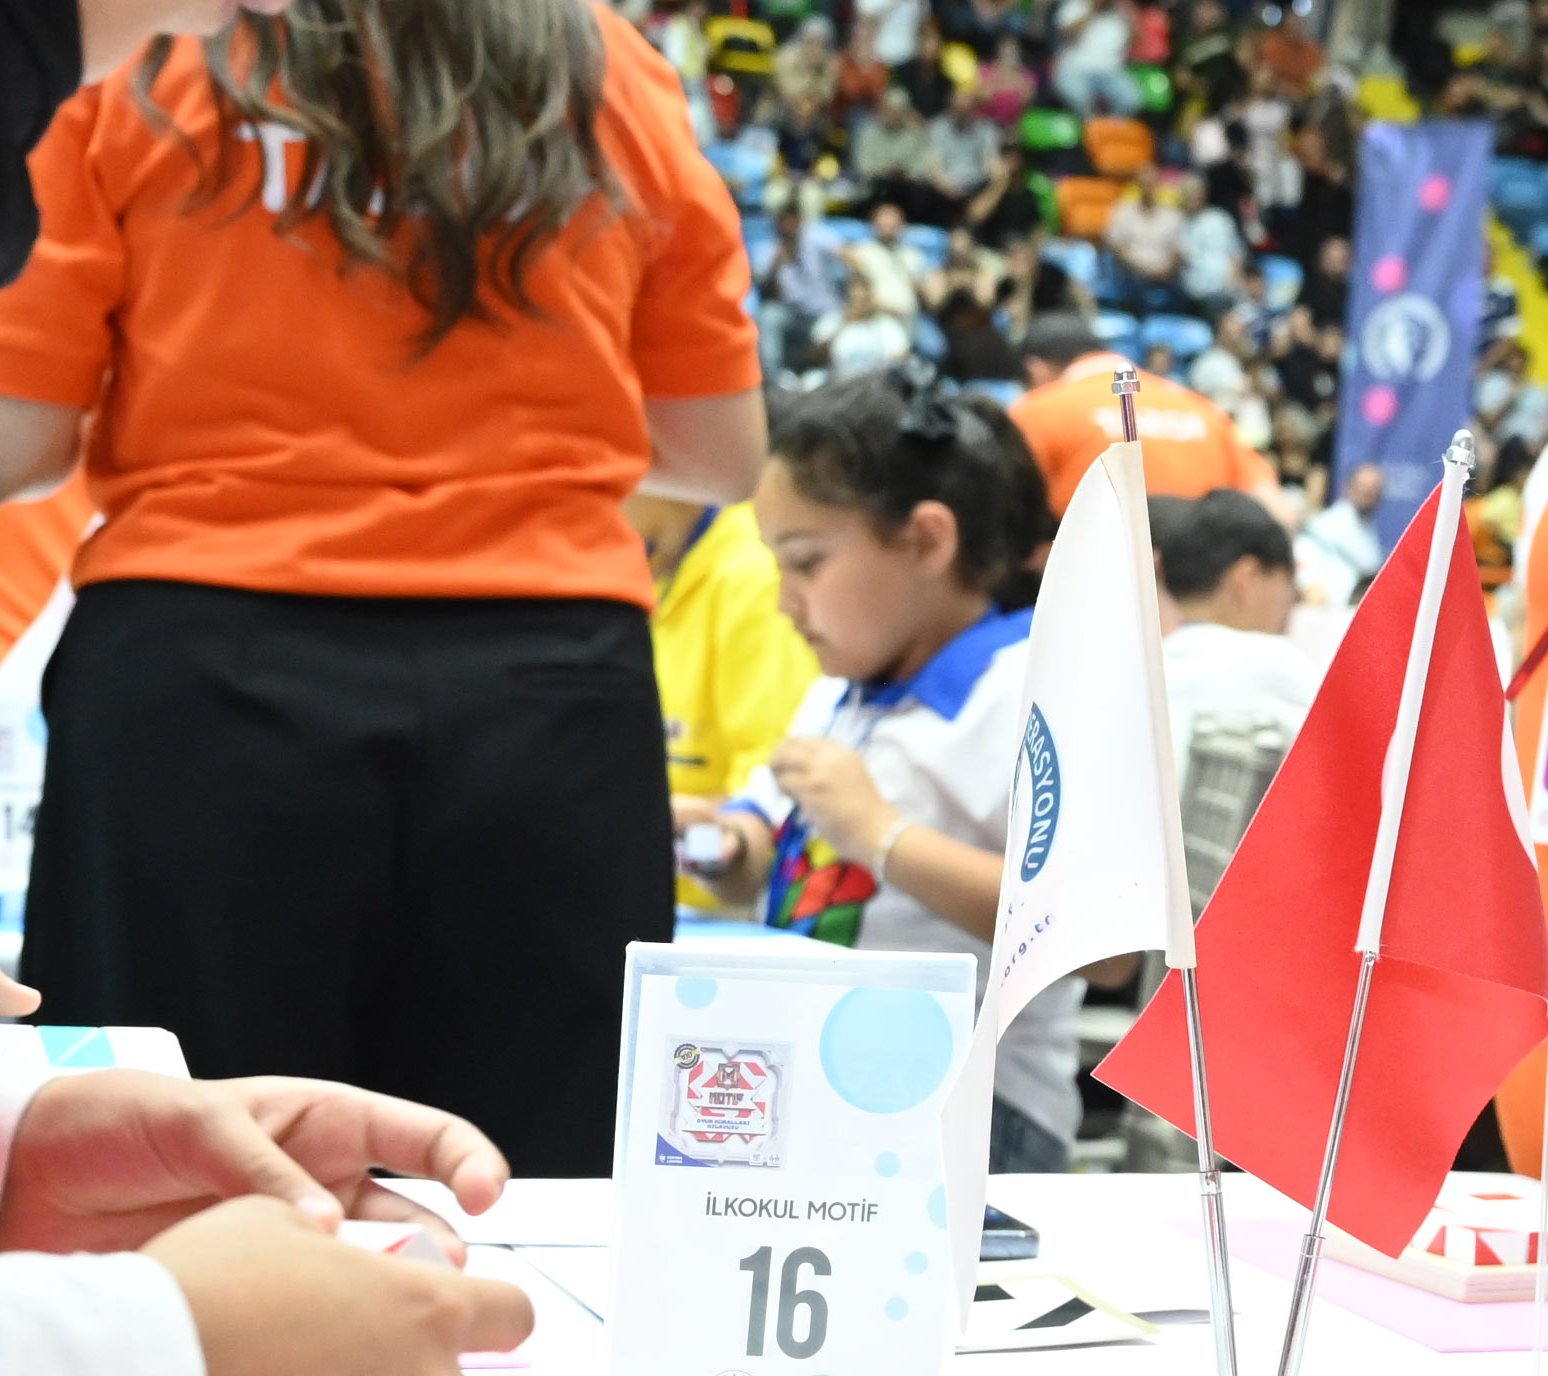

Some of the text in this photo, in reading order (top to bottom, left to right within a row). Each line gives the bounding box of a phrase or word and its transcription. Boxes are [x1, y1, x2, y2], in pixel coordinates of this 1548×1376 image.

[706, 1191, 880, 1223] İLKOKUL MOTİF
[740, 1246, 832, 1359] 16
